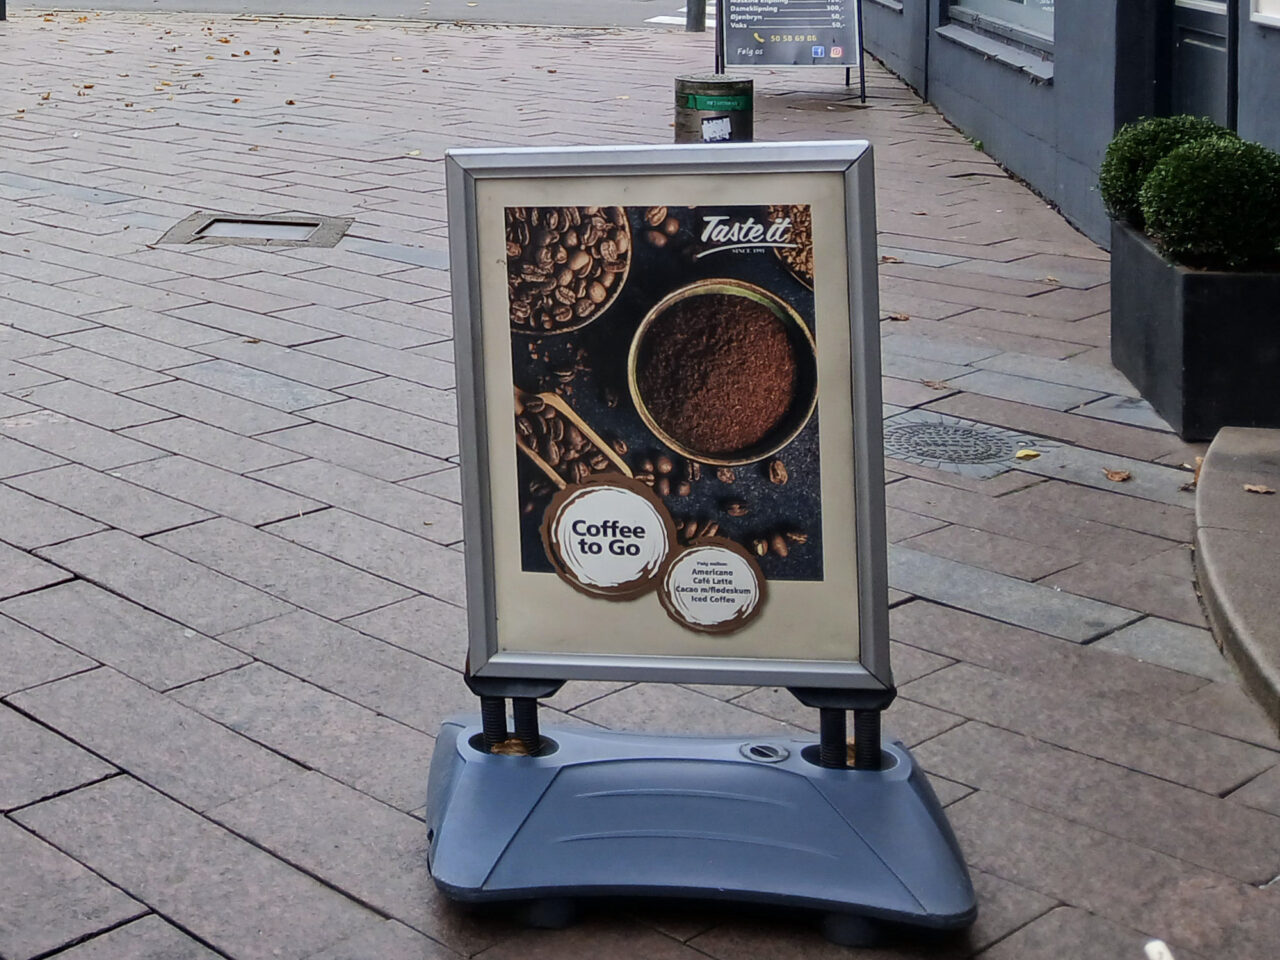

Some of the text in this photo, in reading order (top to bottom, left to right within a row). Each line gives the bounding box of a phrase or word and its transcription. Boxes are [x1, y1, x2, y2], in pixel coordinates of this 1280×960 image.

[730, 5, 778, 13] Dameklipning
[737, 47, 753, 57] Følg
[701, 216, 793, 243] Taste it
[571, 519, 646, 539] Coffee
[577, 538, 641, 556] to Go
[692, 568, 734, 577] Americano
[693, 577, 734, 586] Café Latte
[675, 585, 752, 595] Cacao m/flødeskum
[691, 595, 736, 604] Iced Coffee
